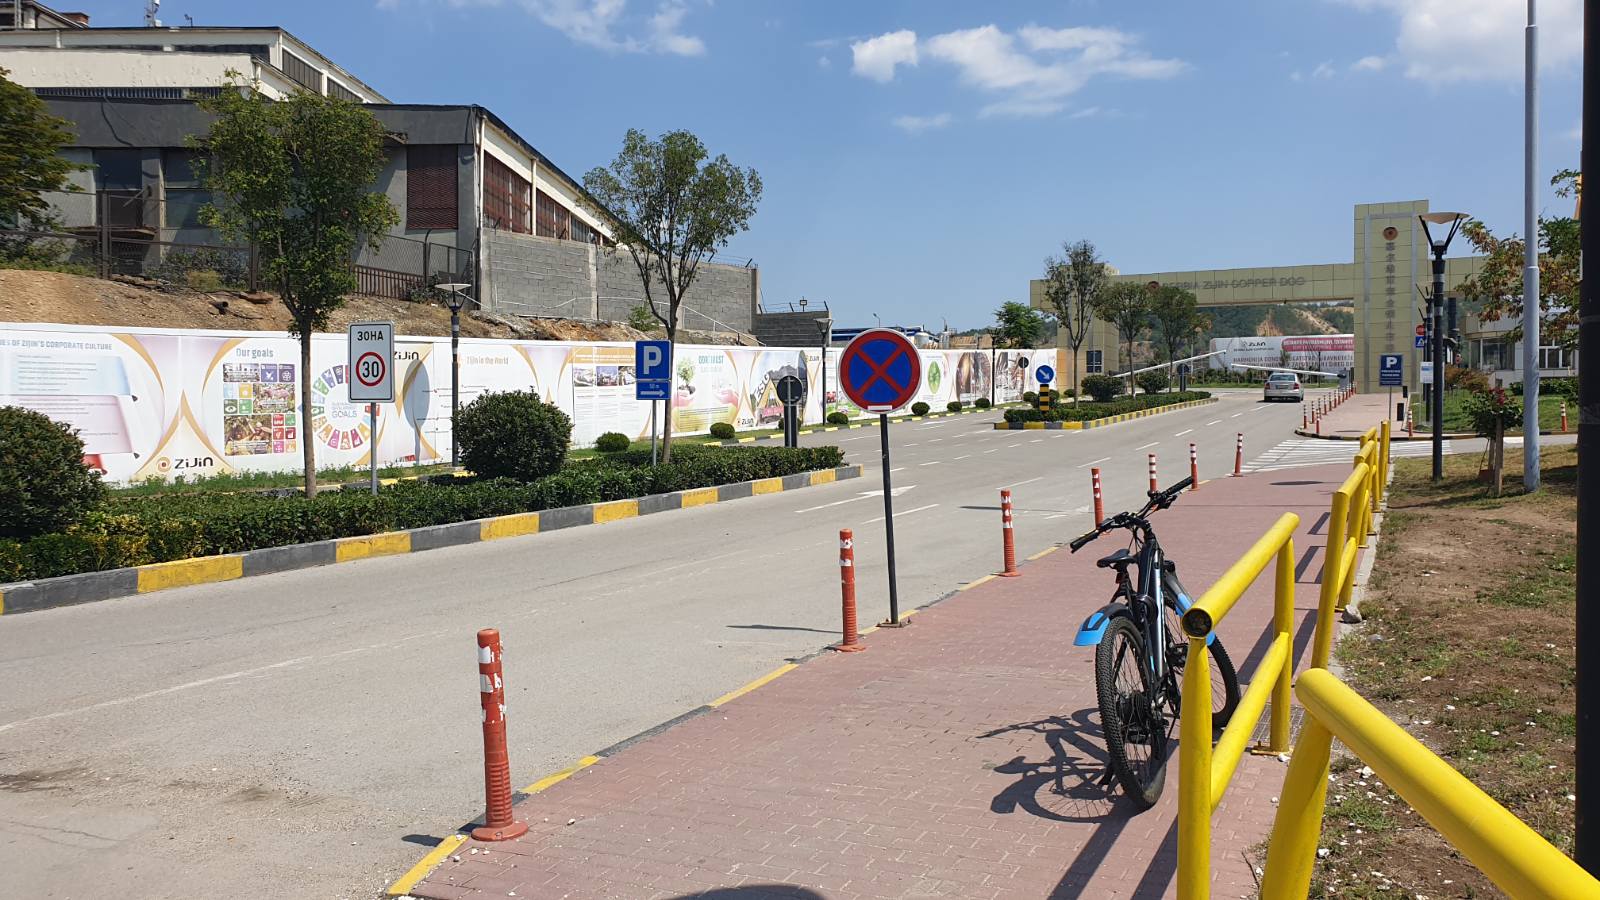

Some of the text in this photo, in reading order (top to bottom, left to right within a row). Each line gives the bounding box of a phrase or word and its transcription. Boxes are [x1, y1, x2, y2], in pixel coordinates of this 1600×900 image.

[46, 341, 83, 349] CORPORATE
[85, 342, 112, 350] CULTURE
[236, 347, 274, 359] Our goals
[643, 345, 662, 375] P
[1386, 356, 1398, 369] P
[362, 360, 380, 378] 30
[331, 410, 357, 418] GOALS
